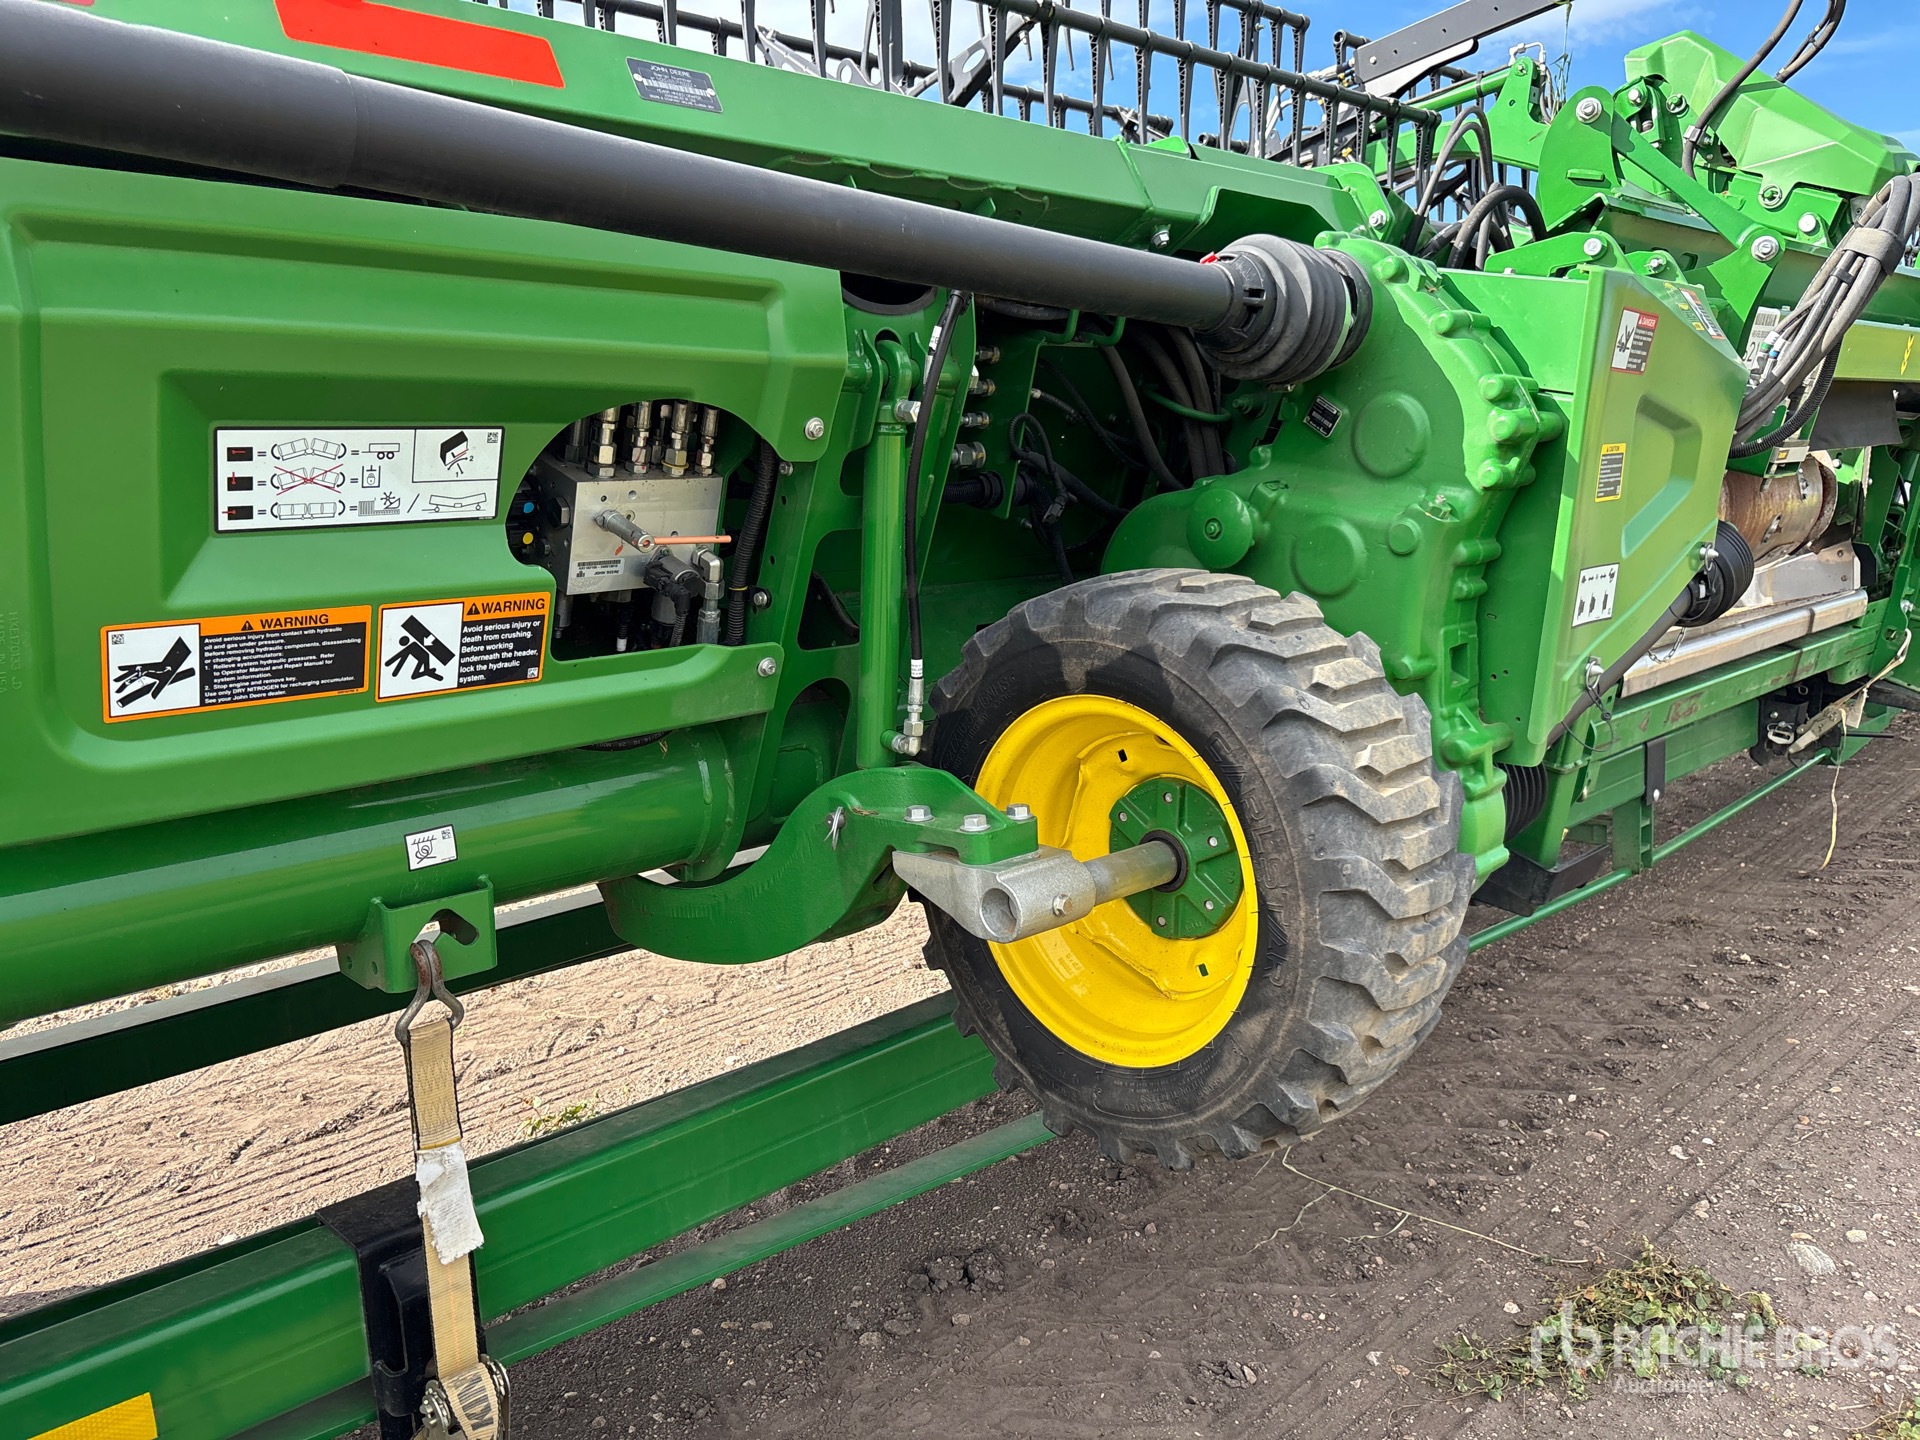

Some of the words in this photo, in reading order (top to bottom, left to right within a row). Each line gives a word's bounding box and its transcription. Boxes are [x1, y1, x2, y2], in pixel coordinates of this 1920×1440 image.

[669, 69, 690, 77] DEERE
[482, 599, 545, 614] WARNING
[260, 614, 329, 629] WARNING
[463, 625, 482, 633] Avoid
[484, 623, 510, 631] serious
[512, 621, 531, 629] injury
[462, 635, 481, 643] death
[501, 631, 533, 640] crushing.
[461, 645, 484, 653] Before
[486, 642, 513, 650] working
[461, 653, 500, 663] underneath
[514, 649, 538, 657] header,
[489, 660, 520, 671] hydraulic
[247, 684, 279, 692] NITROGEN
[321, 676, 355, 684] accumulator.
[459, 675, 486, 683] system.
